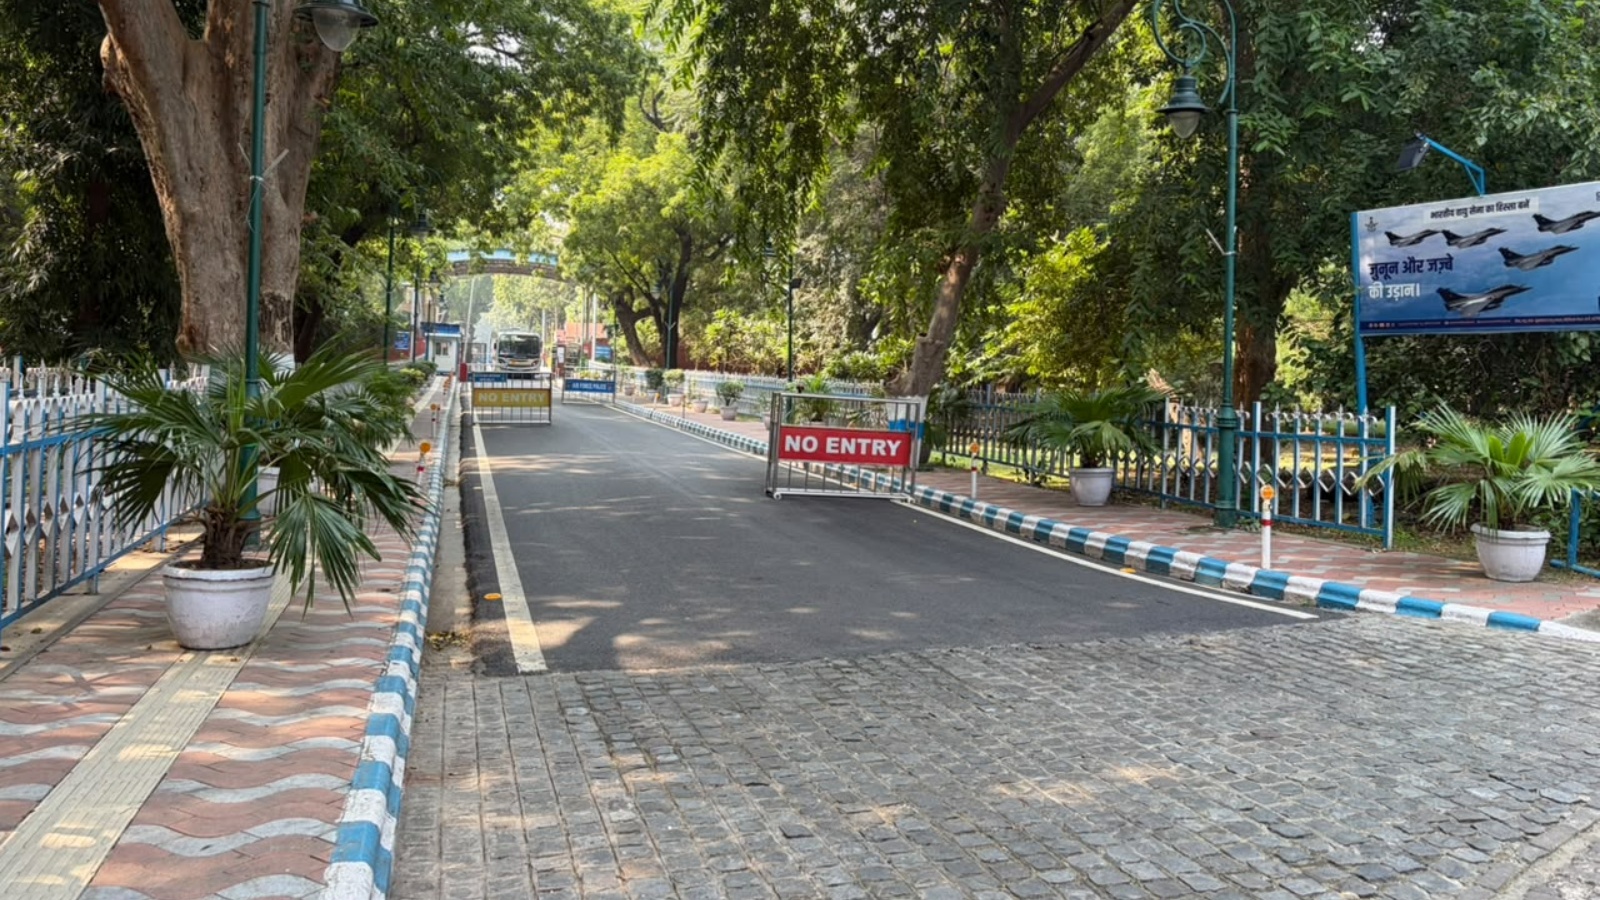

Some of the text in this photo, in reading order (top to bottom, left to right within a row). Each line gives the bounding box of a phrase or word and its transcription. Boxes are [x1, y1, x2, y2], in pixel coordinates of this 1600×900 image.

[1430, 207, 1455, 219] भारतीय
[1456, 207, 1468, 218] वायु
[1469, 204, 1484, 215] सेना
[1485, 204, 1495, 214] का
[1495, 201, 1517, 212] हिस्सा
[1368, 261, 1400, 281] जुनून
[1402, 256, 1425, 274] और
[1368, 281, 1383, 299] की
[478, 392, 545, 403] NO ENTRY
[784, 435, 902, 457] NO ENTRY
